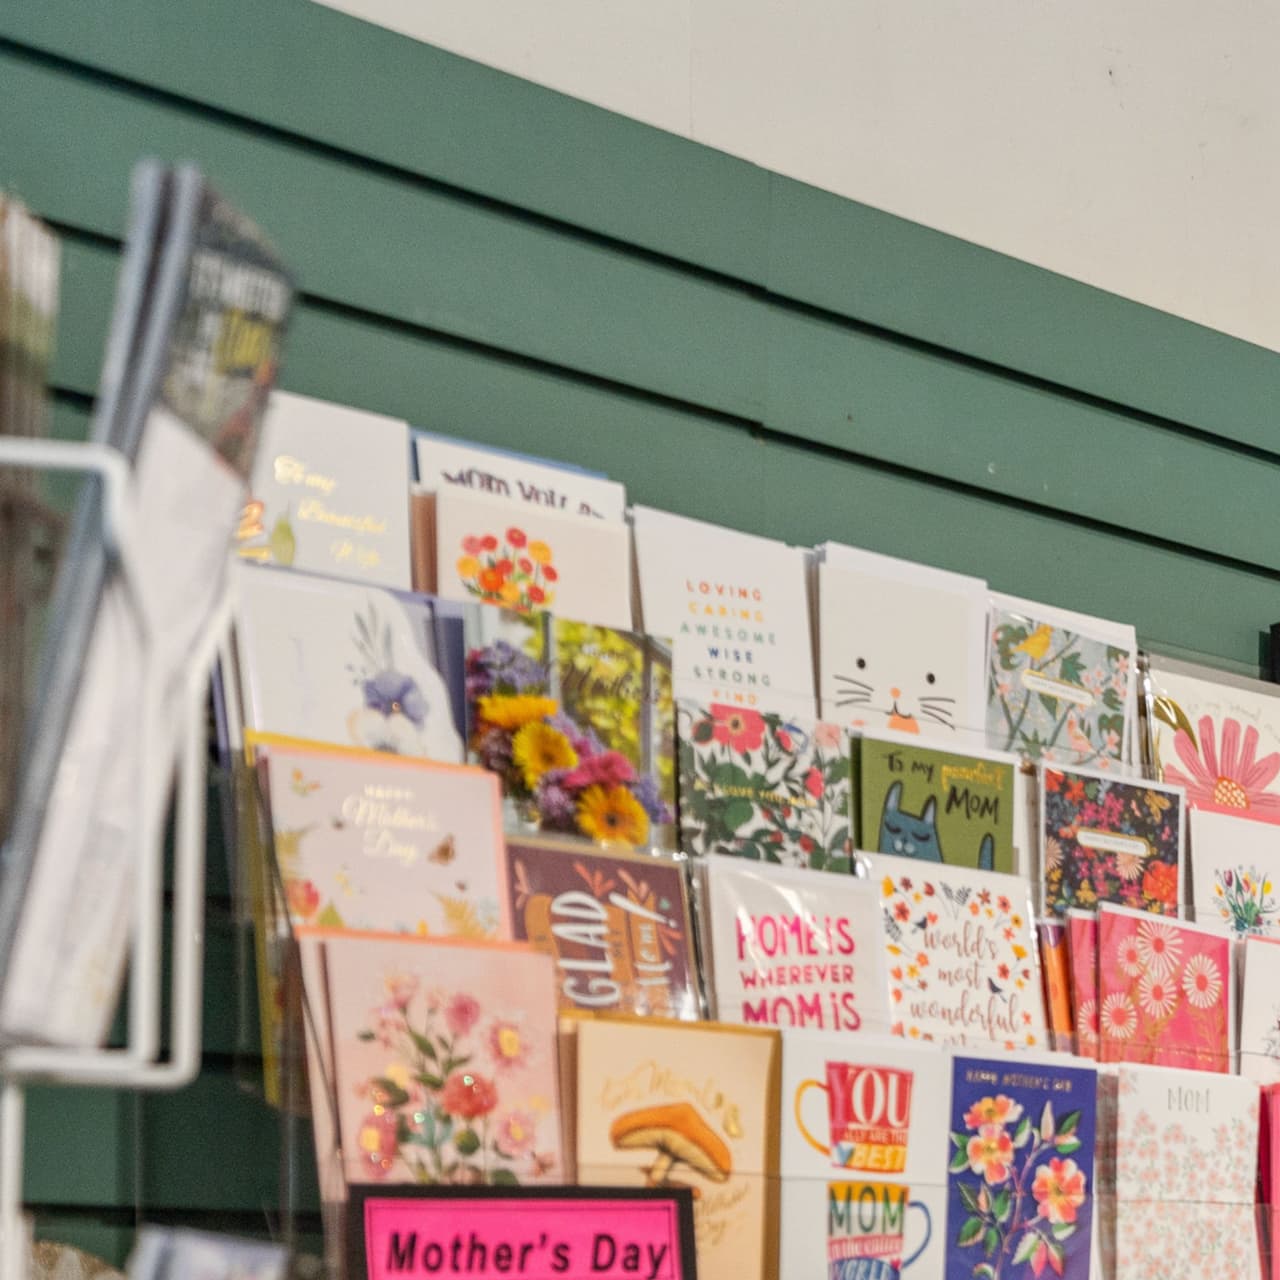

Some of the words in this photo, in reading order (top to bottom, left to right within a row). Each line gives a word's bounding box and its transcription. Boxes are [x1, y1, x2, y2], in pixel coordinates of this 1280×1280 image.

[685, 579, 763, 601] LOVING
[689, 601, 765, 621] CARING
[680, 621, 777, 645] AWESOME
[708, 647, 754, 663] WISE
[693, 665, 771, 687] STRONG
[912, 762, 933, 782] my
[739, 963, 854, 989] WHEREVER
[938, 962, 979, 989] most
[829, 1185, 905, 1237] MOM
[387, 1232, 570, 1272] Mother's
[591, 1234, 668, 1280] Day
